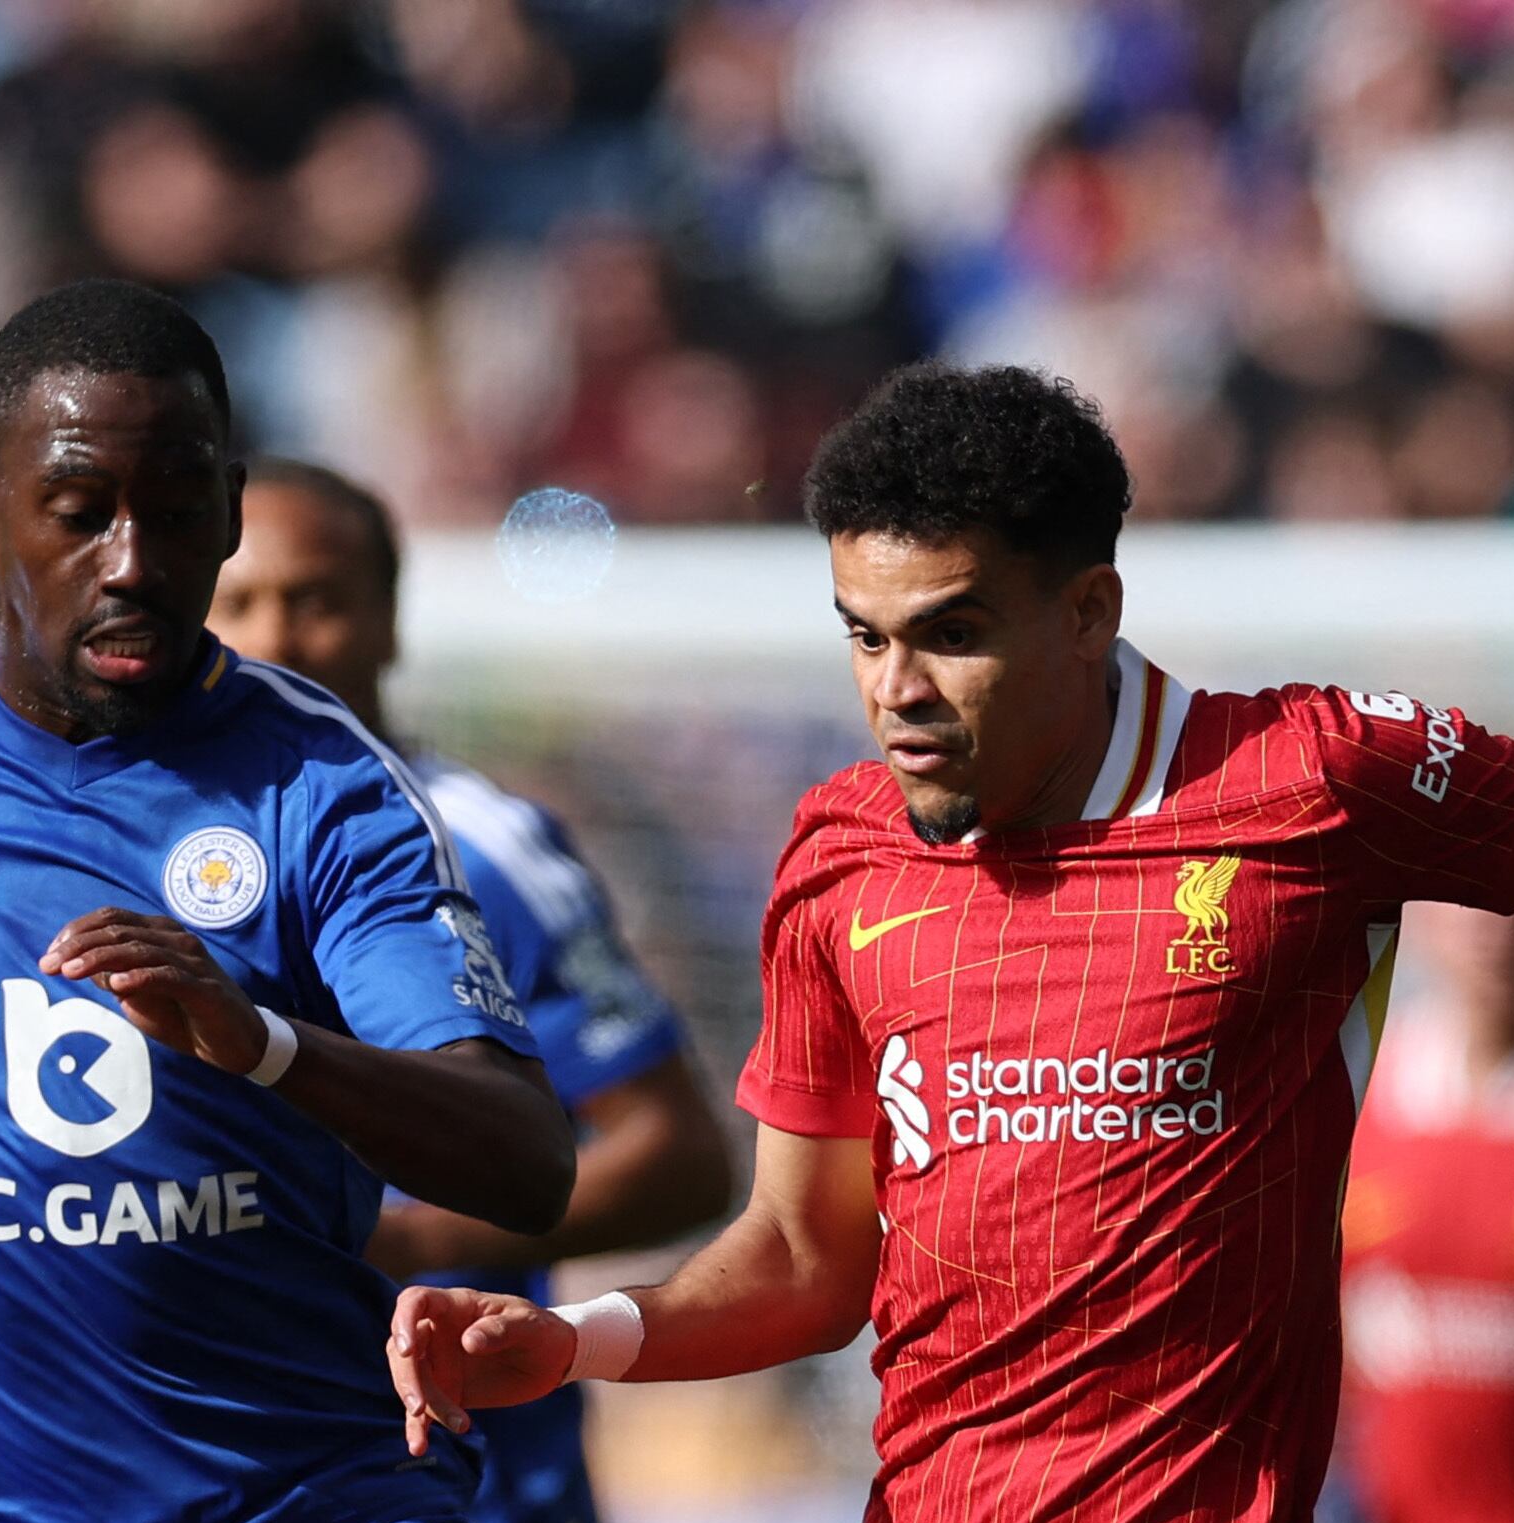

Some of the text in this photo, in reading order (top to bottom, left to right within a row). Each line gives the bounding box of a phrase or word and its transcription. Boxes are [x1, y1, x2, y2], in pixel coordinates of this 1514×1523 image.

[1411, 703, 1465, 802] Expe
[177, 837, 255, 876] LEICESTER CITY
[175, 878, 254, 917] FOOTBALL CLUB
[1166, 947, 1236, 974] L.F.C.
[452, 983, 528, 1027] SAIGO
[947, 1048, 1216, 1098] standard
[948, 1090, 1223, 1144] chartered
